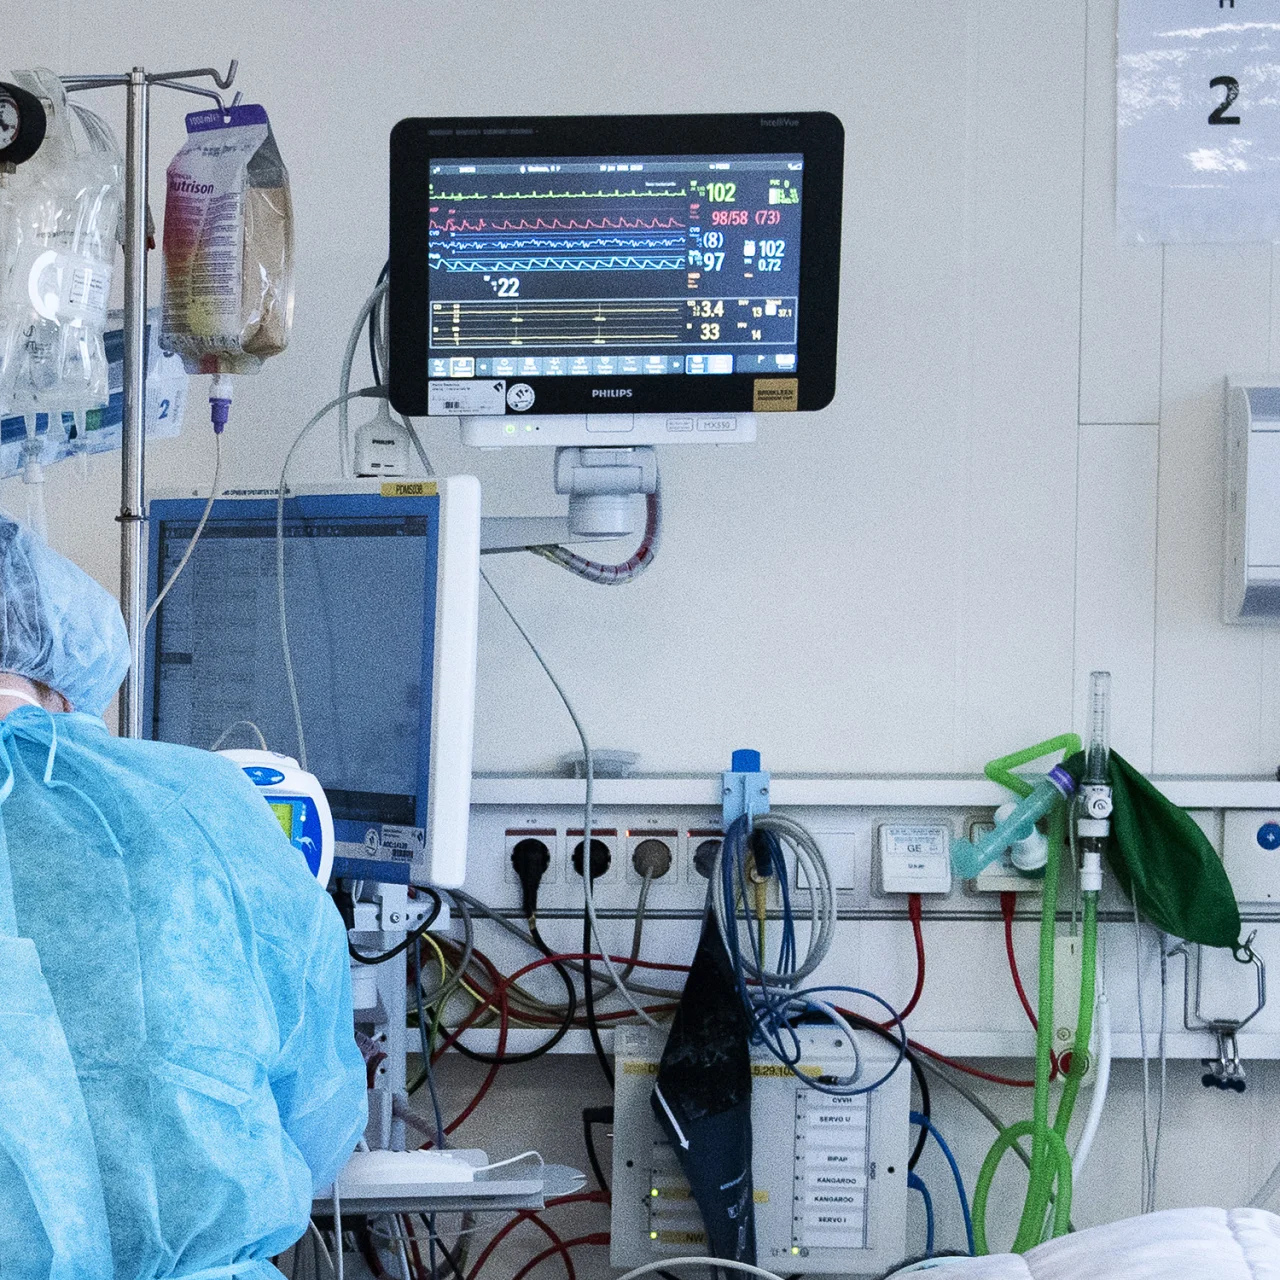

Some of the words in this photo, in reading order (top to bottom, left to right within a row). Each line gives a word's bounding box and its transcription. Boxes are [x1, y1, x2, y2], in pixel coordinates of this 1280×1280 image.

[1208, 76, 1240, 125] 2
[706, 182, 736, 203] 102
[712, 210, 748, 226] 98/58
[754, 210, 781, 225] (73)
[702, 232, 724, 248] (8)
[758, 240, 786, 257] 102
[703, 252, 726, 272] 97
[757, 258, 781, 272] 0.72
[497, 278, 520, 297] 22
[701, 300, 724, 318] 3.4
[752, 306, 763, 318] 13
[700, 323, 720, 340] 33
[751, 329, 762, 341] 14
[592, 388, 633, 399] PHILIPS
